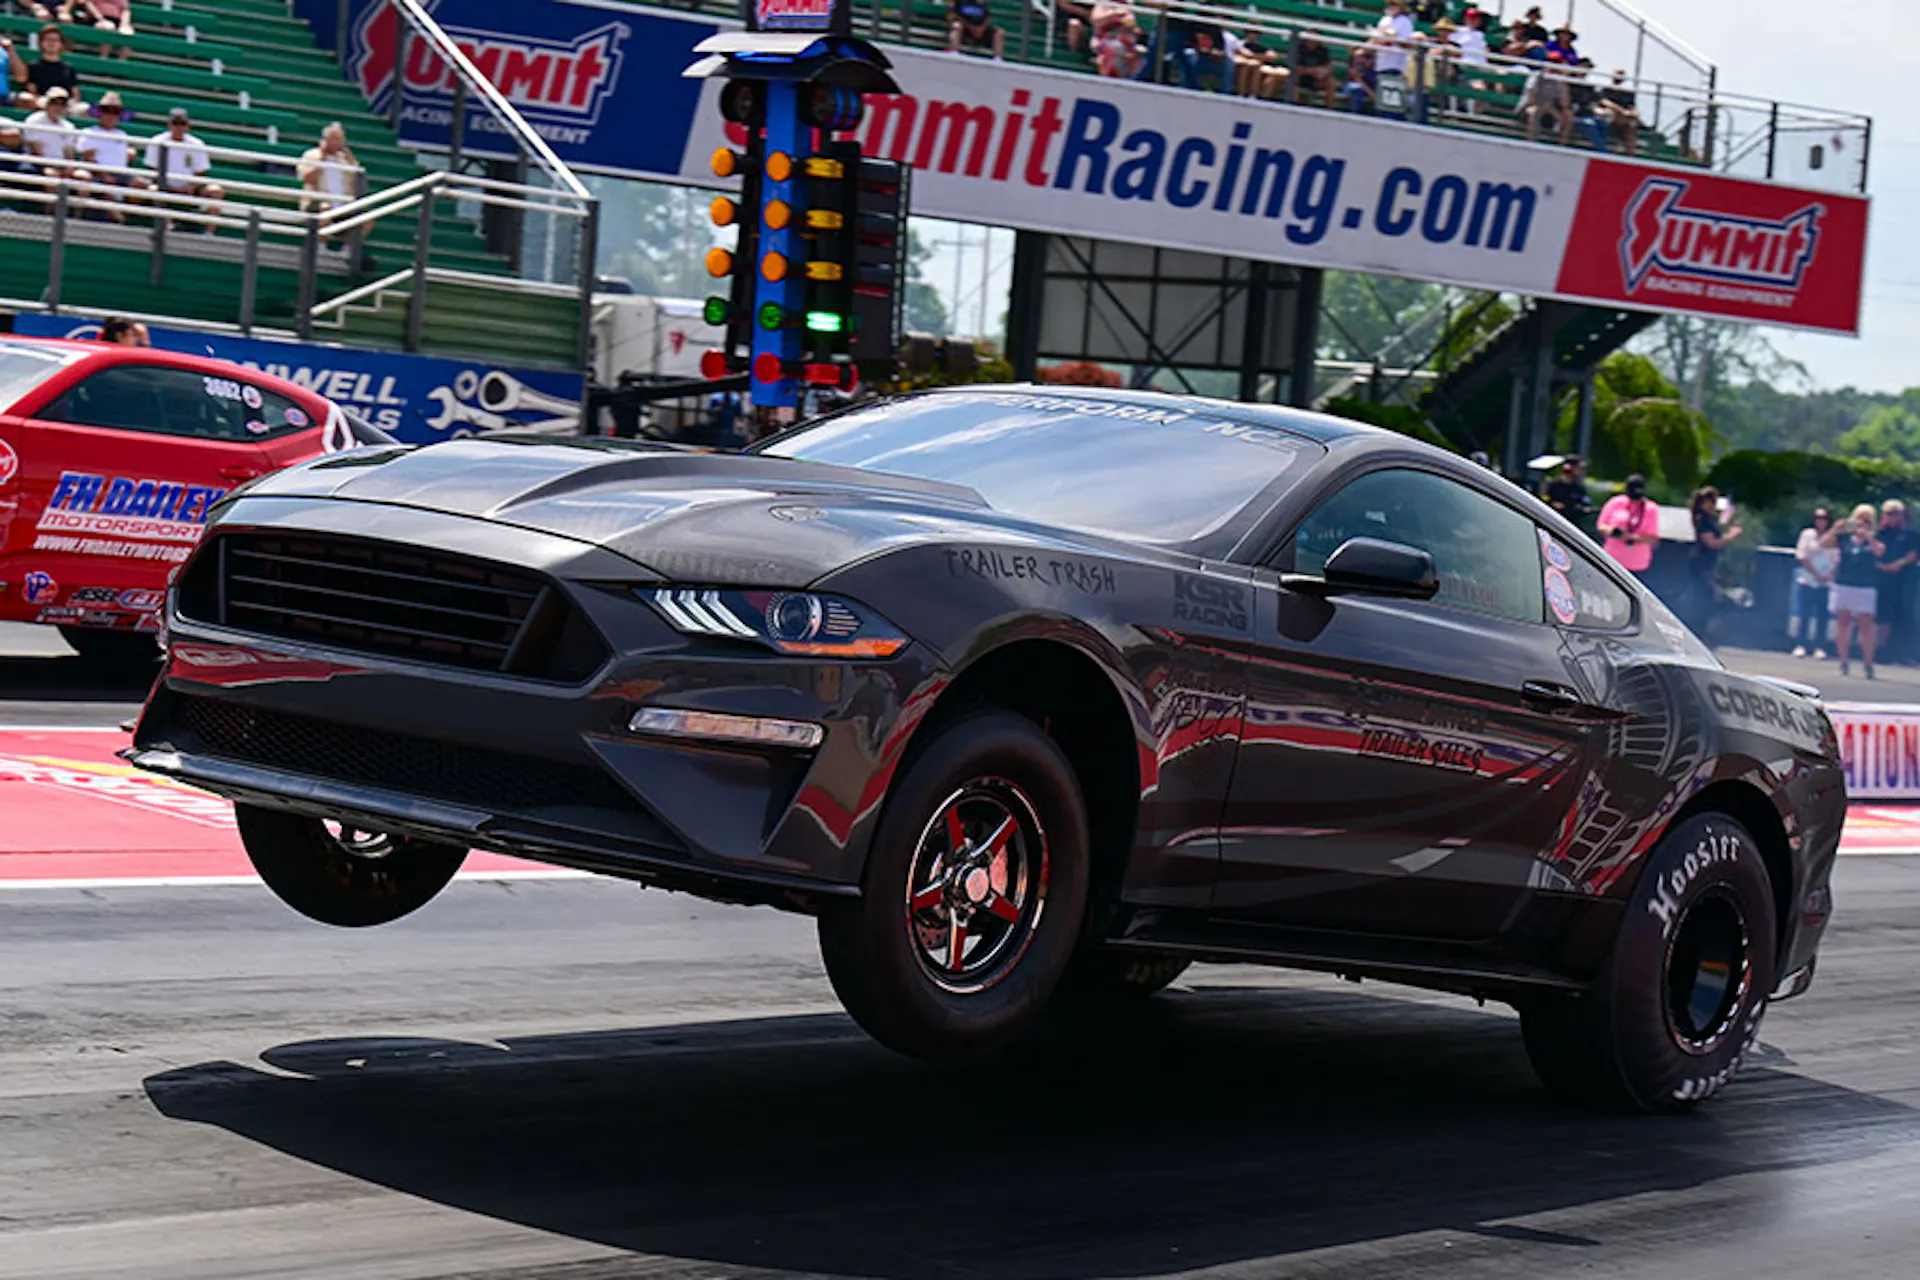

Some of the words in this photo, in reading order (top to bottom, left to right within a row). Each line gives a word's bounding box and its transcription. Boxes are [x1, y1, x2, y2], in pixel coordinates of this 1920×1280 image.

[723, 88, 1538, 253] mmitRacing.com
[946, 550, 1047, 585] TRAILER
[1048, 561, 1116, 596] TRASH
[1173, 602, 1247, 631] RACING
[1707, 682, 1800, 734] COBRA
[1834, 721, 1920, 789] ATION
[1647, 827, 1741, 939] Hoosier
